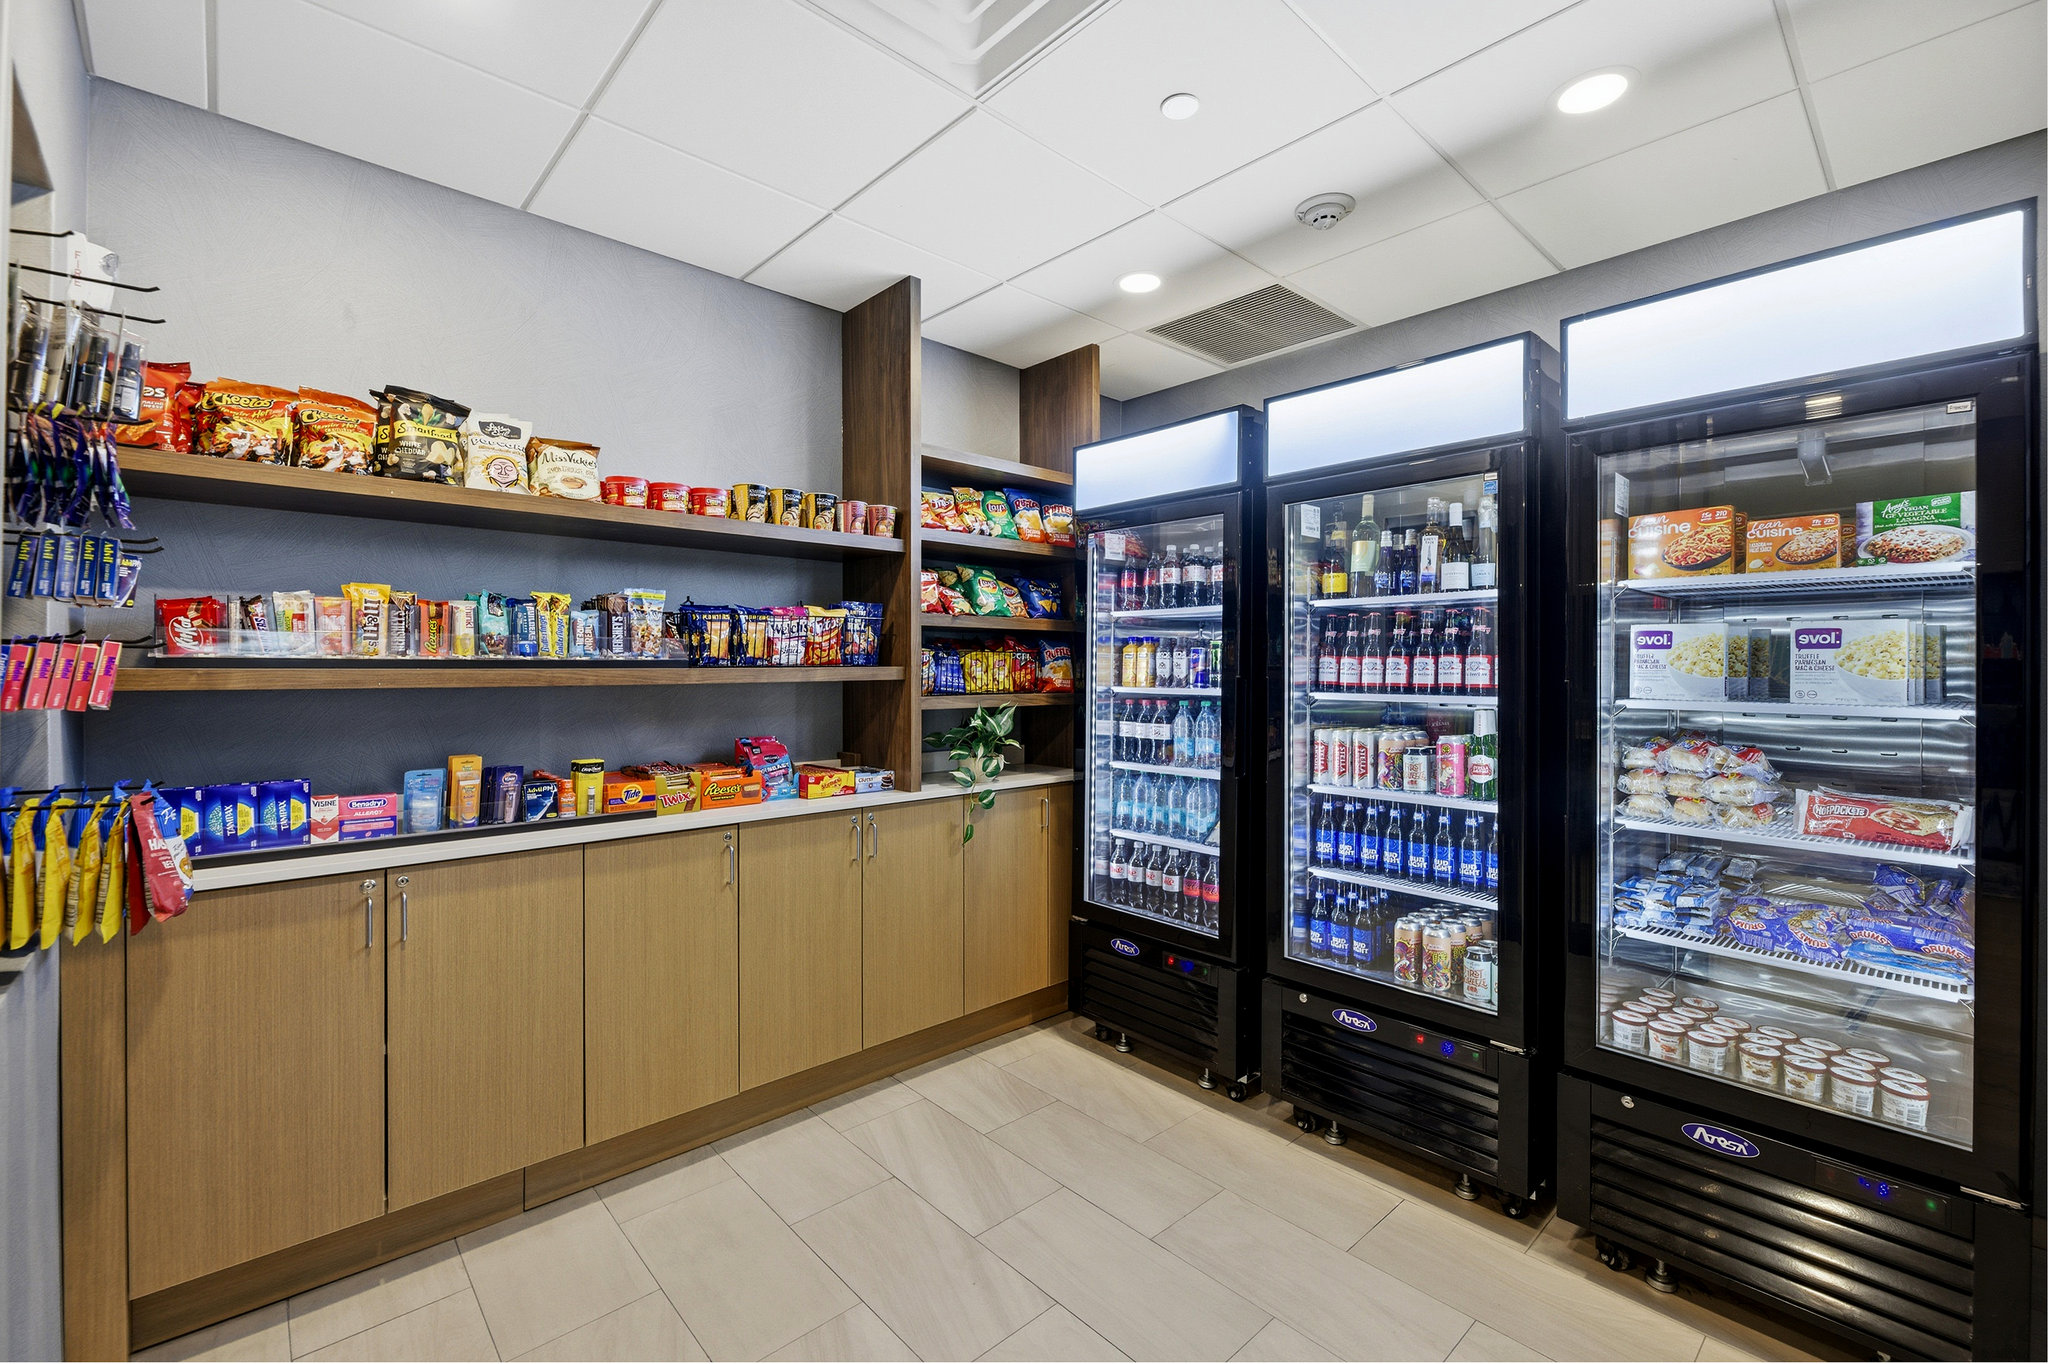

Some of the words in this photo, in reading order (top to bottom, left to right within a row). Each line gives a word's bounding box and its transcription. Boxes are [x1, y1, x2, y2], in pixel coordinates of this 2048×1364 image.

[214, 392, 273, 409] Cheetos
[1881, 500, 1911, 518] Amy's
[1750, 520, 1785, 534] Lean
[1895, 515, 1936, 524] LASAGNA
[611, 615, 624, 654] HERSHEY'S
[1797, 631, 1841, 645] evol.
[623, 789, 641, 801] Tide
[703, 782, 742, 797] Reese's
[312, 800, 337, 808] VISINE
[351, 800, 385, 809] Benadryl
[659, 791, 691, 808] Twix
[223, 804, 237, 837] TAMPAX
[278, 799, 290, 831] TAMPAX
